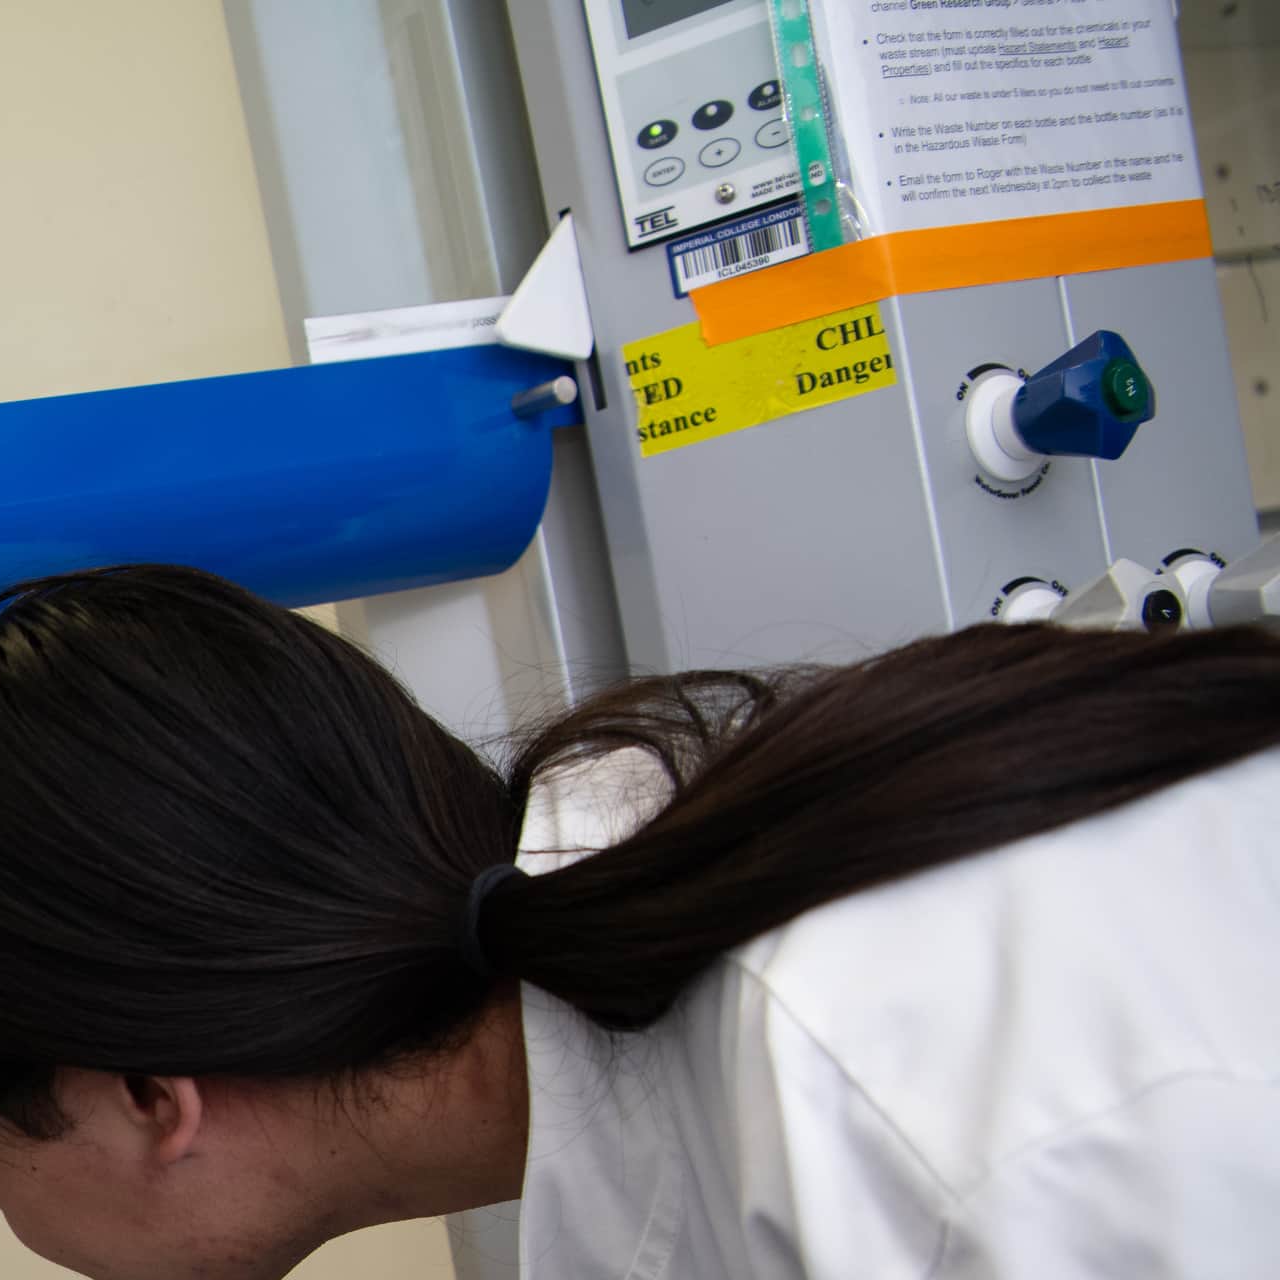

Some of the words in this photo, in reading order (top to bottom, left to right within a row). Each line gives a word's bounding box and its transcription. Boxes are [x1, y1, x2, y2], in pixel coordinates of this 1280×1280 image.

[910, 0, 938, 10] Green
[876, 32, 905, 45] Check
[909, 32, 925, 43] that
[927, 31, 941, 42] the
[943, 29, 963, 40] form
[974, 28, 1008, 40] correctly
[879, 48, 907, 60] waste
[909, 47, 939, 59] stream
[968, 43, 996, 56] update
[1079, 39, 1096, 49] and
[934, 62, 951, 73] and
[891, 126, 916, 138] Write
[918, 125, 932, 136] the
[934, 123, 963, 135] Waste
[965, 120, 1000, 132] Number
[1059, 116, 1076, 126] and
[1078, 114, 1092, 124] the
[1120, 109, 1152, 121] number
[905, 142, 919, 152] the
[921, 138, 970, 151] Hazardous
[972, 135, 1000, 147] Waste
[899, 174, 924, 187] Email
[926, 173, 940, 184] the
[942, 171, 963, 183] form
[977, 168, 1003, 182] Roger
[1005, 165, 1022, 177] with
[1024, 164, 1038, 175] the
[1065, 160, 1102, 172] Number
[1113, 158, 1127, 168] the
[1154, 154, 1170, 165] and
[901, 190, 916, 202] will
[918, 188, 950, 201] confirm
[952, 186, 967, 198] the
[969, 184, 989, 196] next
[991, 179, 1040, 193] Wednesday
[1113, 172, 1127, 183] the
[636, 210, 678, 234] TEL
[672, 233, 714, 252] IMPERIAL
[716, 219, 762, 239] COLLEGE
[763, 205, 803, 227] LONDON
[815, 314, 886, 352] CHL
[632, 376, 683, 406] ED
